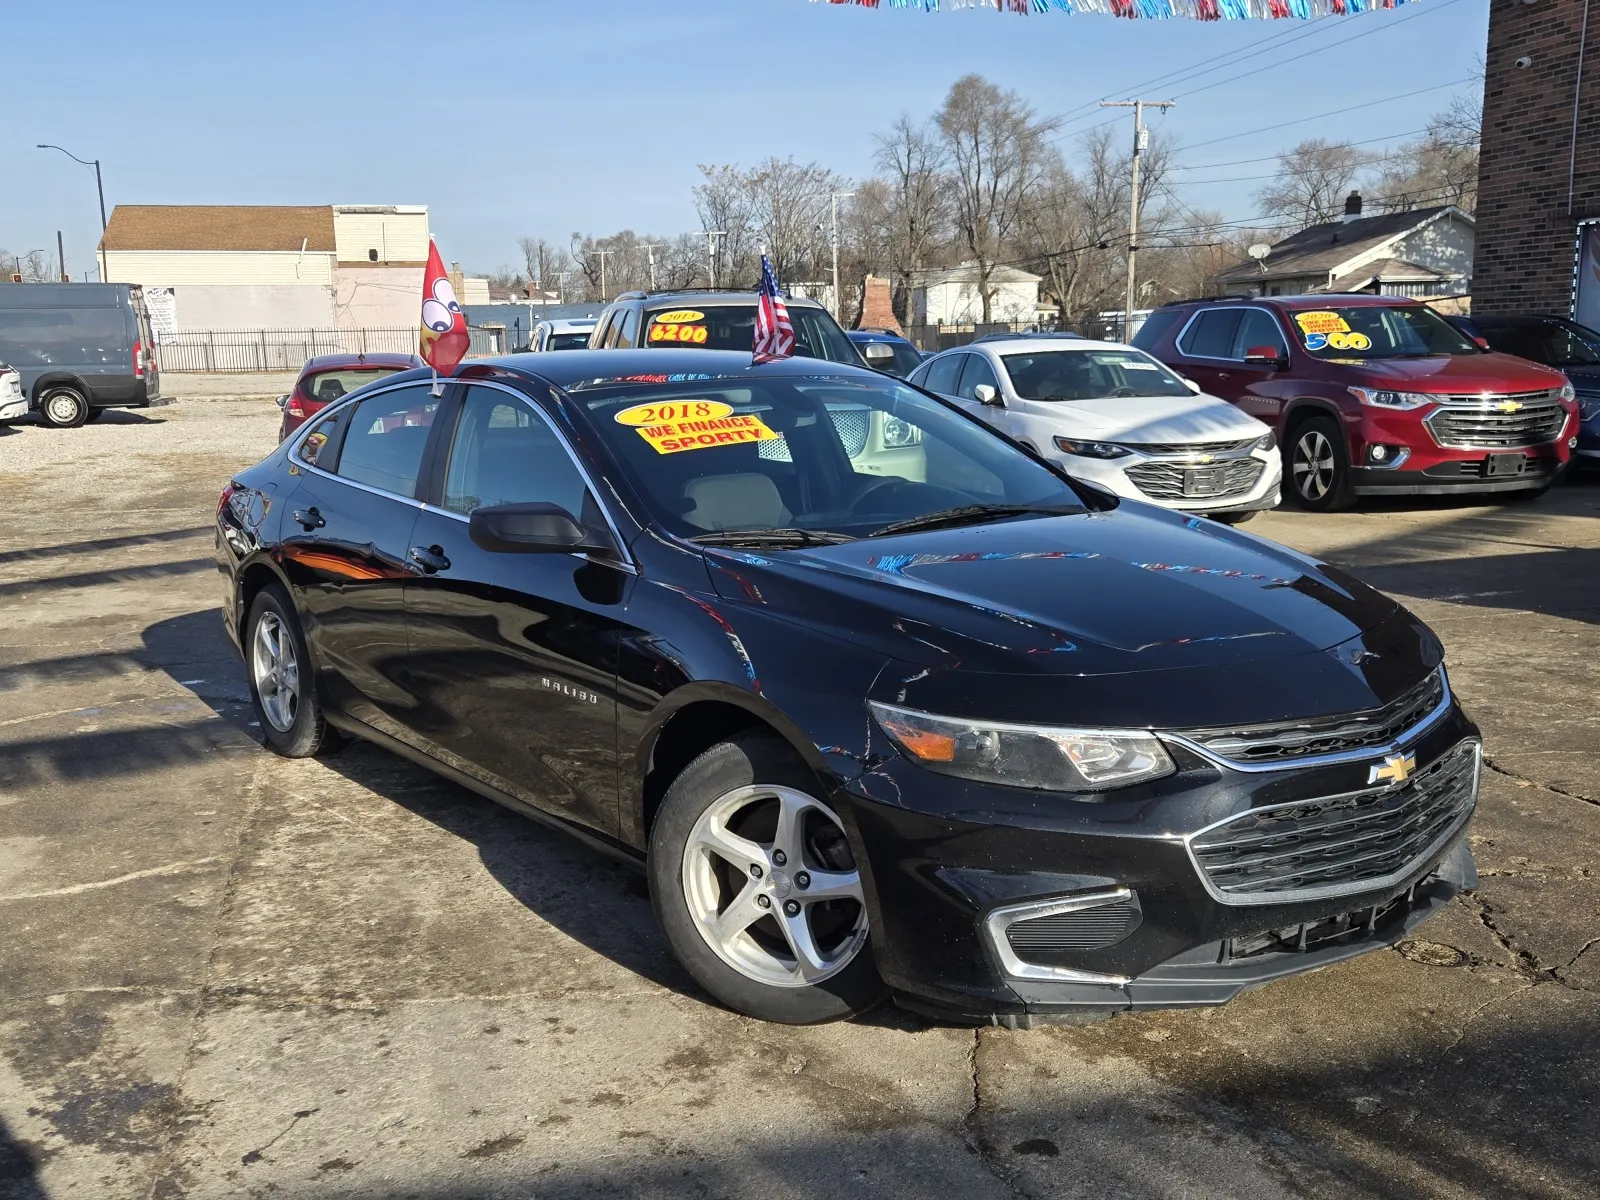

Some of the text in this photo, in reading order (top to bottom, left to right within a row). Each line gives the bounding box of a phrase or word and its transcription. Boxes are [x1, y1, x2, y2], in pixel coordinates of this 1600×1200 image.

[666, 313, 696, 321] 2013
[650, 324, 708, 342] 6200
[1304, 332, 1372, 350] 500
[640, 402, 711, 423] 2018
[644, 417, 755, 438] WE FINANCE
[661, 429, 763, 451] SPORTY
[542, 678, 597, 704] MALIBU
